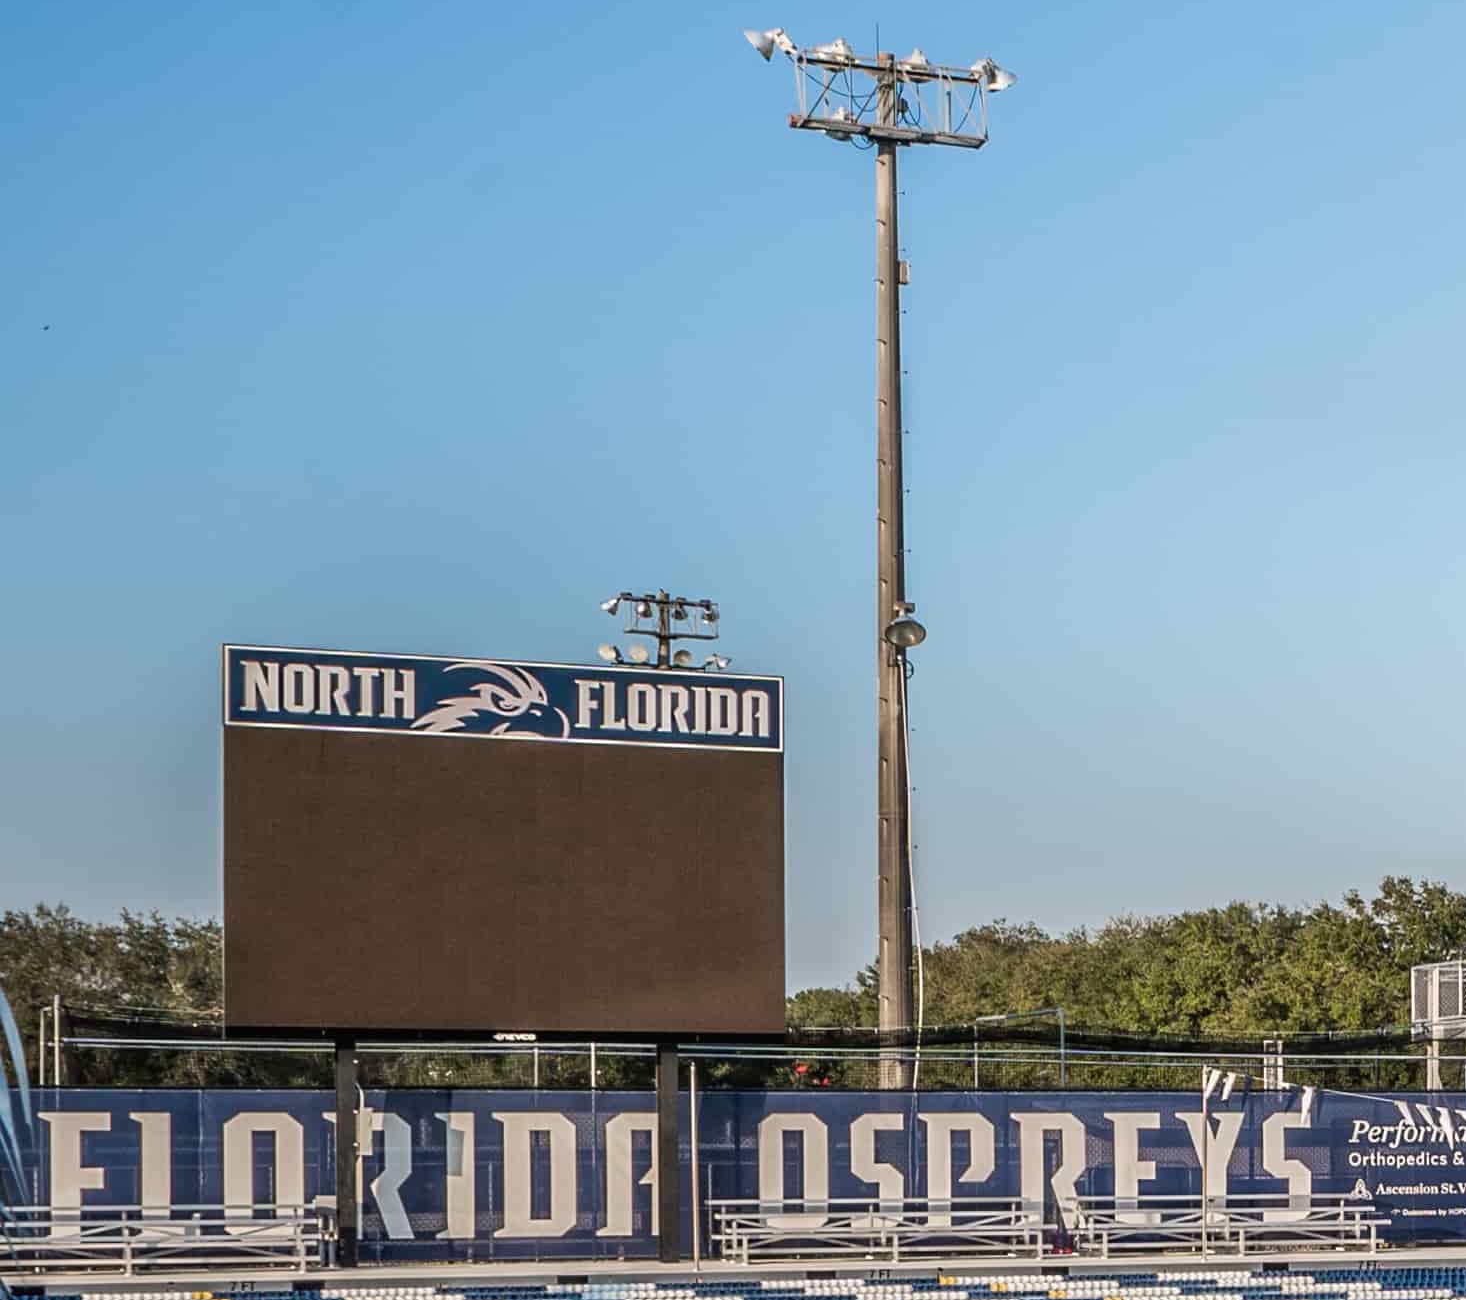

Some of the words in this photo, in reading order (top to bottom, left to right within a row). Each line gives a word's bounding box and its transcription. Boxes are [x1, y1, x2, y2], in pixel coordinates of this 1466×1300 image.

[240, 660, 416, 719] NORTH
[574, 679, 770, 737] FLORIDA
[757, 1111, 1313, 1229] OSPREYS
[1348, 1151, 1448, 1169] Orthopedics
[1453, 1151, 1465, 1167] &
[1376, 1182, 1439, 1196] Ascension
